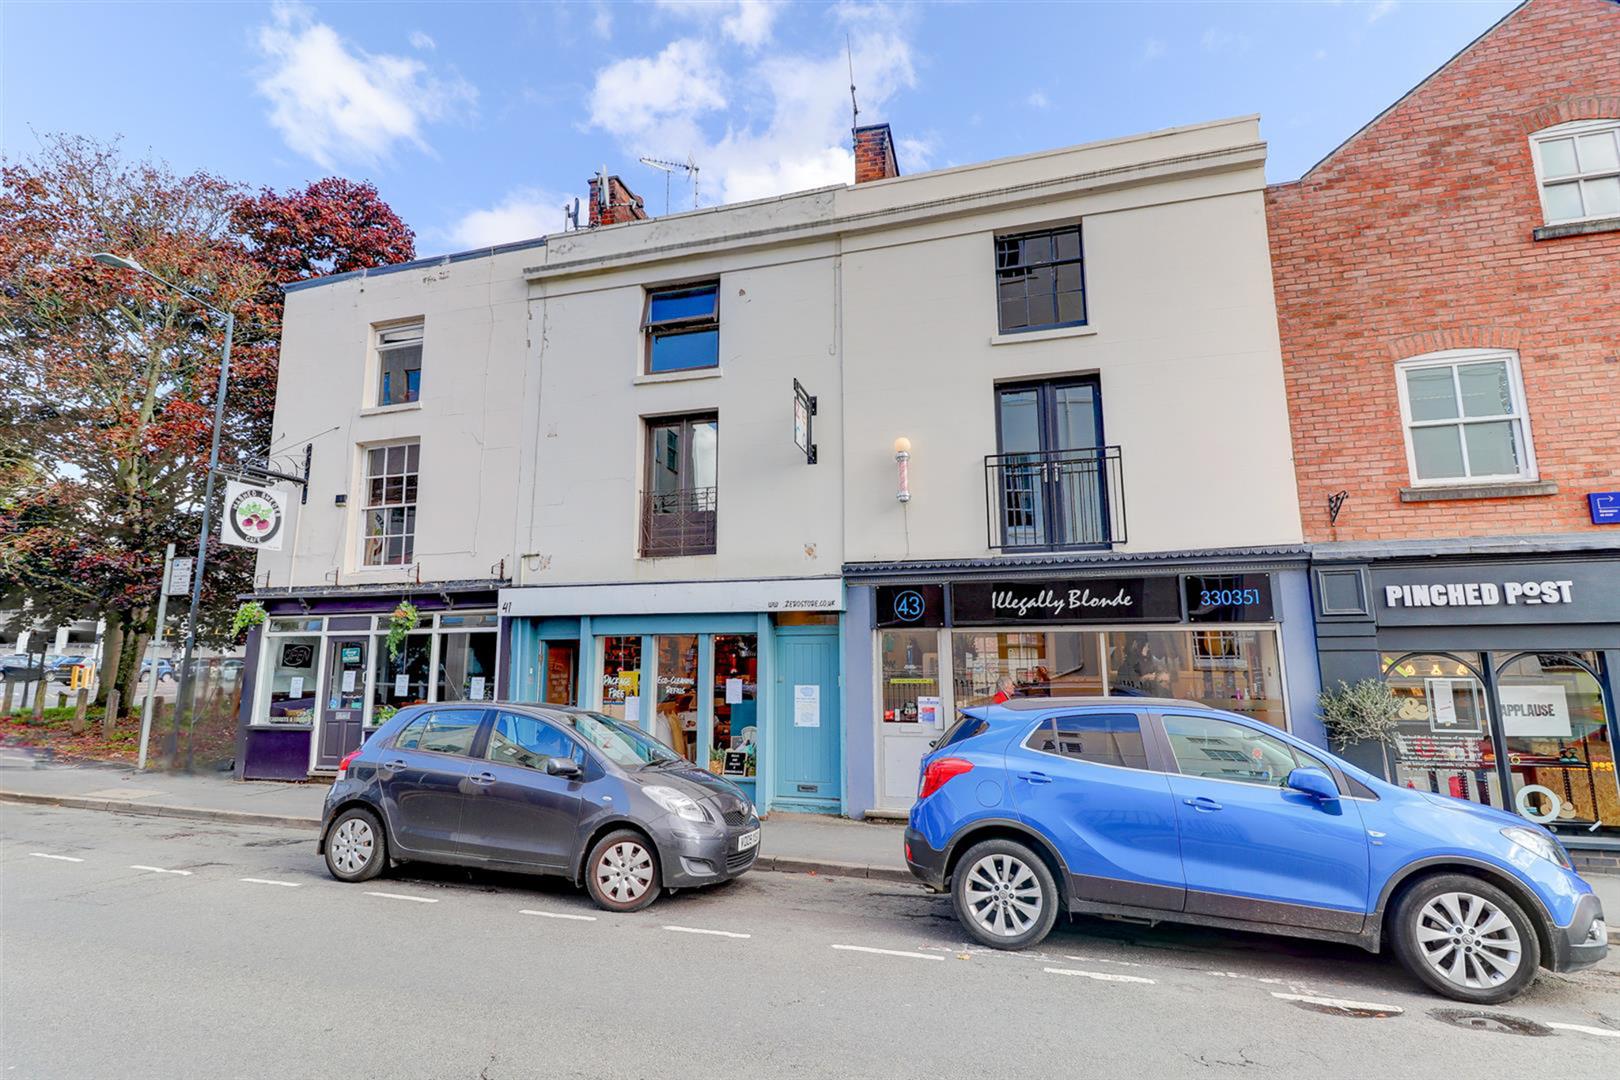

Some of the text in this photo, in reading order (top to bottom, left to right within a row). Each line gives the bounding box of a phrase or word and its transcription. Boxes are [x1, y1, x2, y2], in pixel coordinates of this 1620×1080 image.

[991, 588, 1133, 616] Illegally Blonde
[1200, 589, 1260, 606] 330351
[1385, 580, 1573, 607] PINCHED POST
[502, 601, 512, 613] 41
[897, 596, 920, 615] 43
